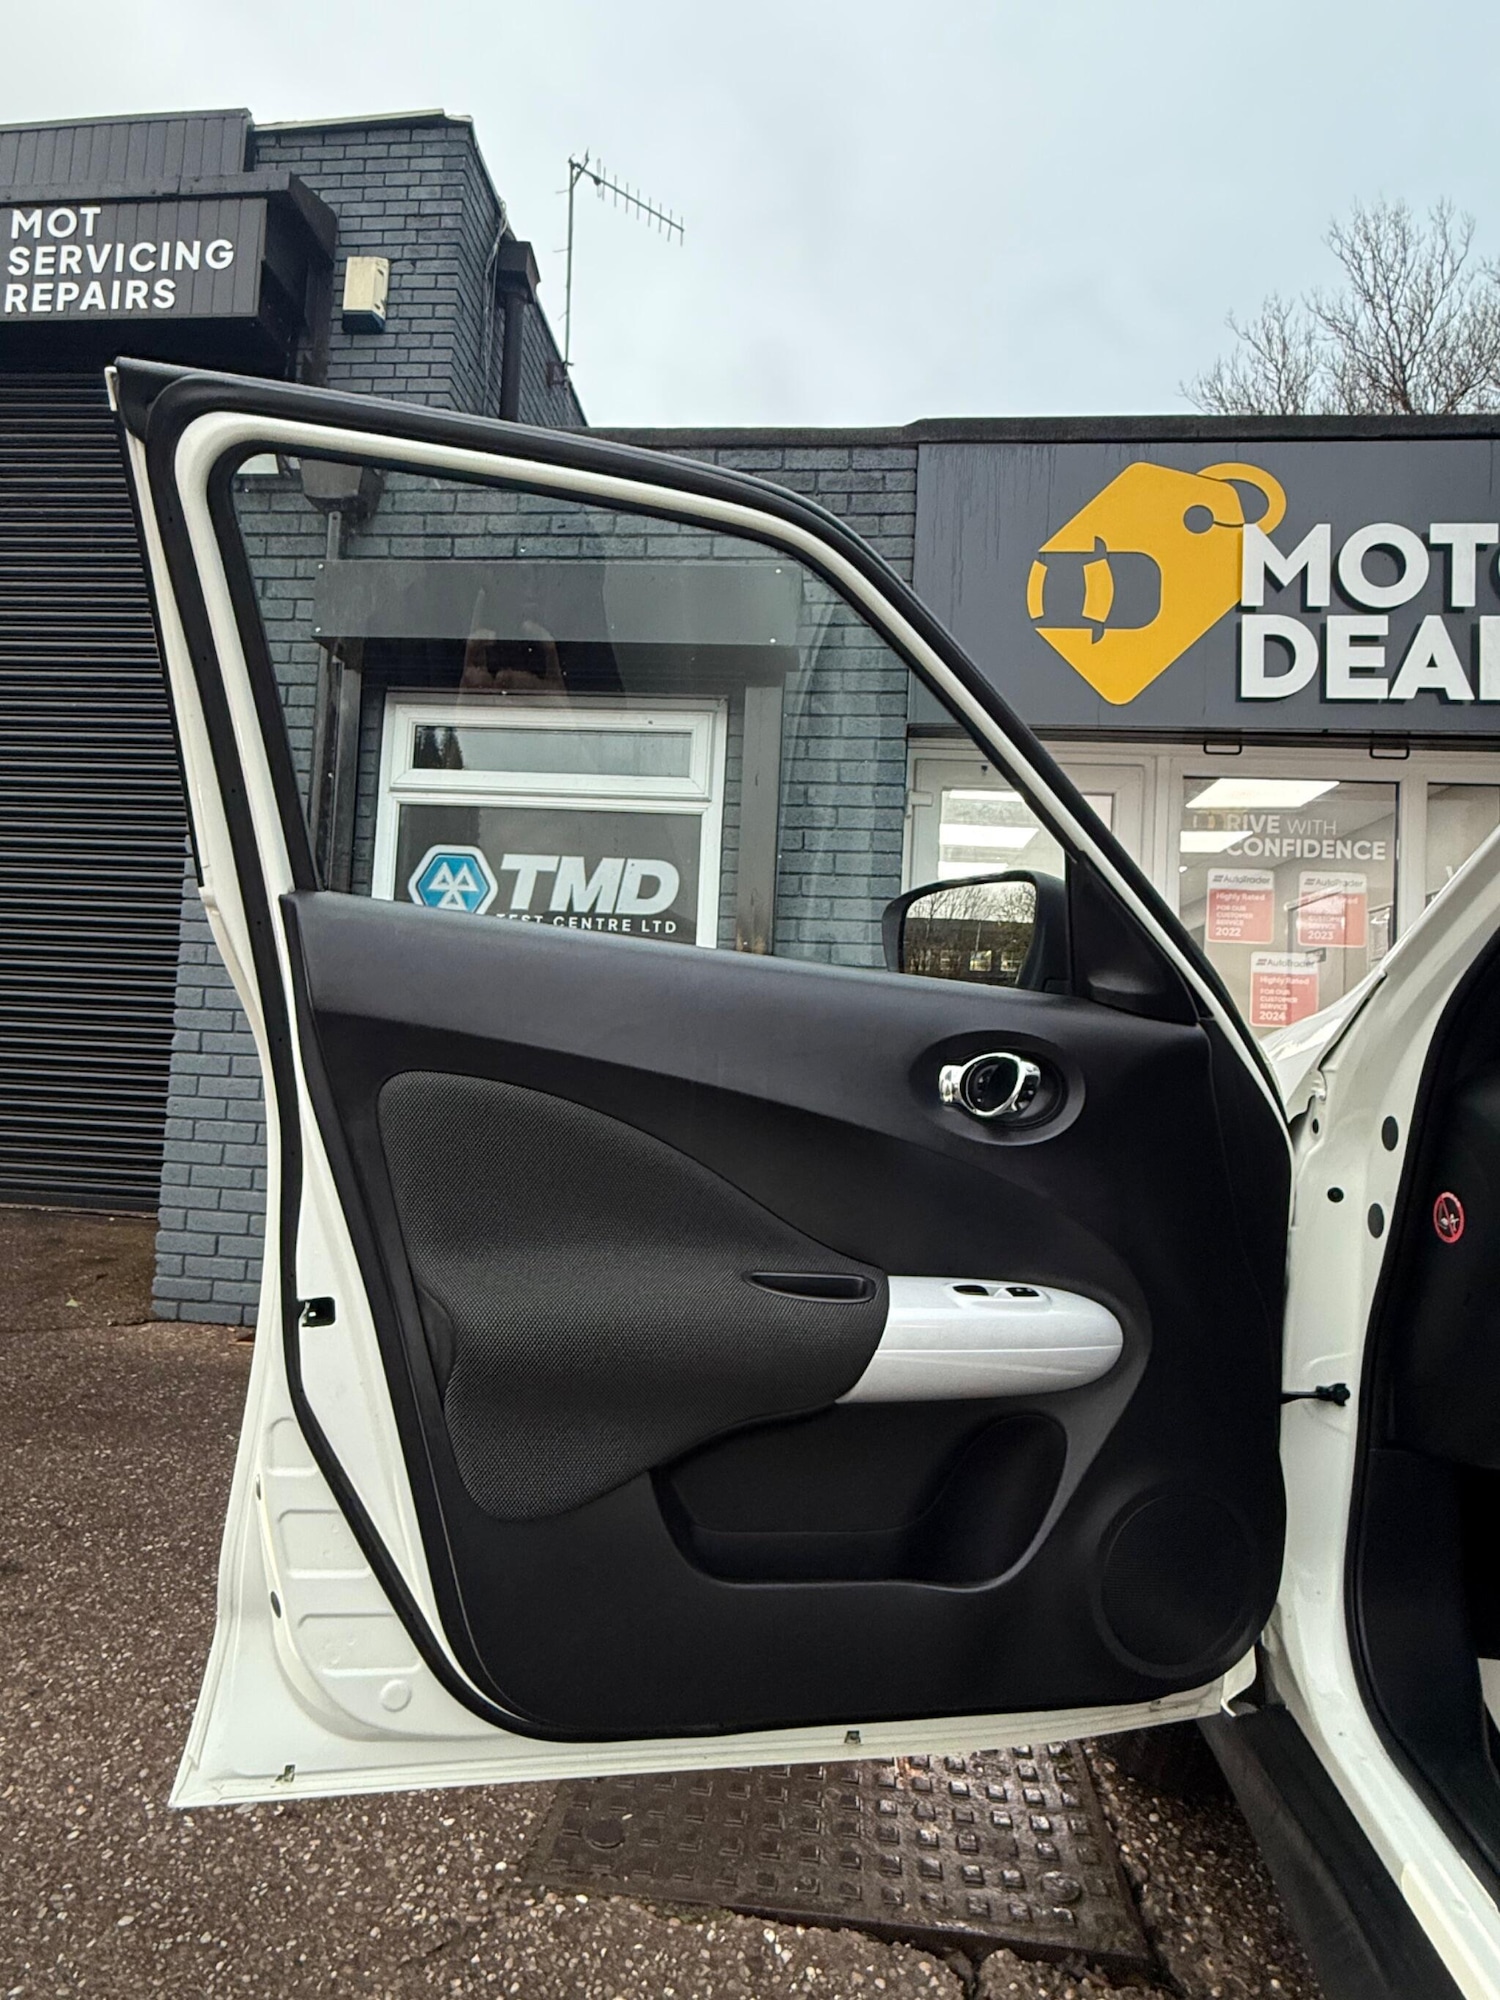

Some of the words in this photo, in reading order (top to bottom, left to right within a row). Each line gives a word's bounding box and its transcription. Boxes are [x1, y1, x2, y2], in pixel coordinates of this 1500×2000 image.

[11, 207, 101, 239] MOT
[7, 239, 235, 276] SERVICING
[4, 278, 177, 313] REPAIRS
[1241, 523, 1500, 608] MOT
[1287, 819, 1337, 836] WITH
[501, 854, 680, 915] TMD
[553, 916, 632, 931] CENTRE
[641, 920, 677, 934] LTD
[1215, 927, 1242, 937] 2022
[1308, 930, 1334, 940] 2023
[1259, 1011, 1287, 1022] 2024
